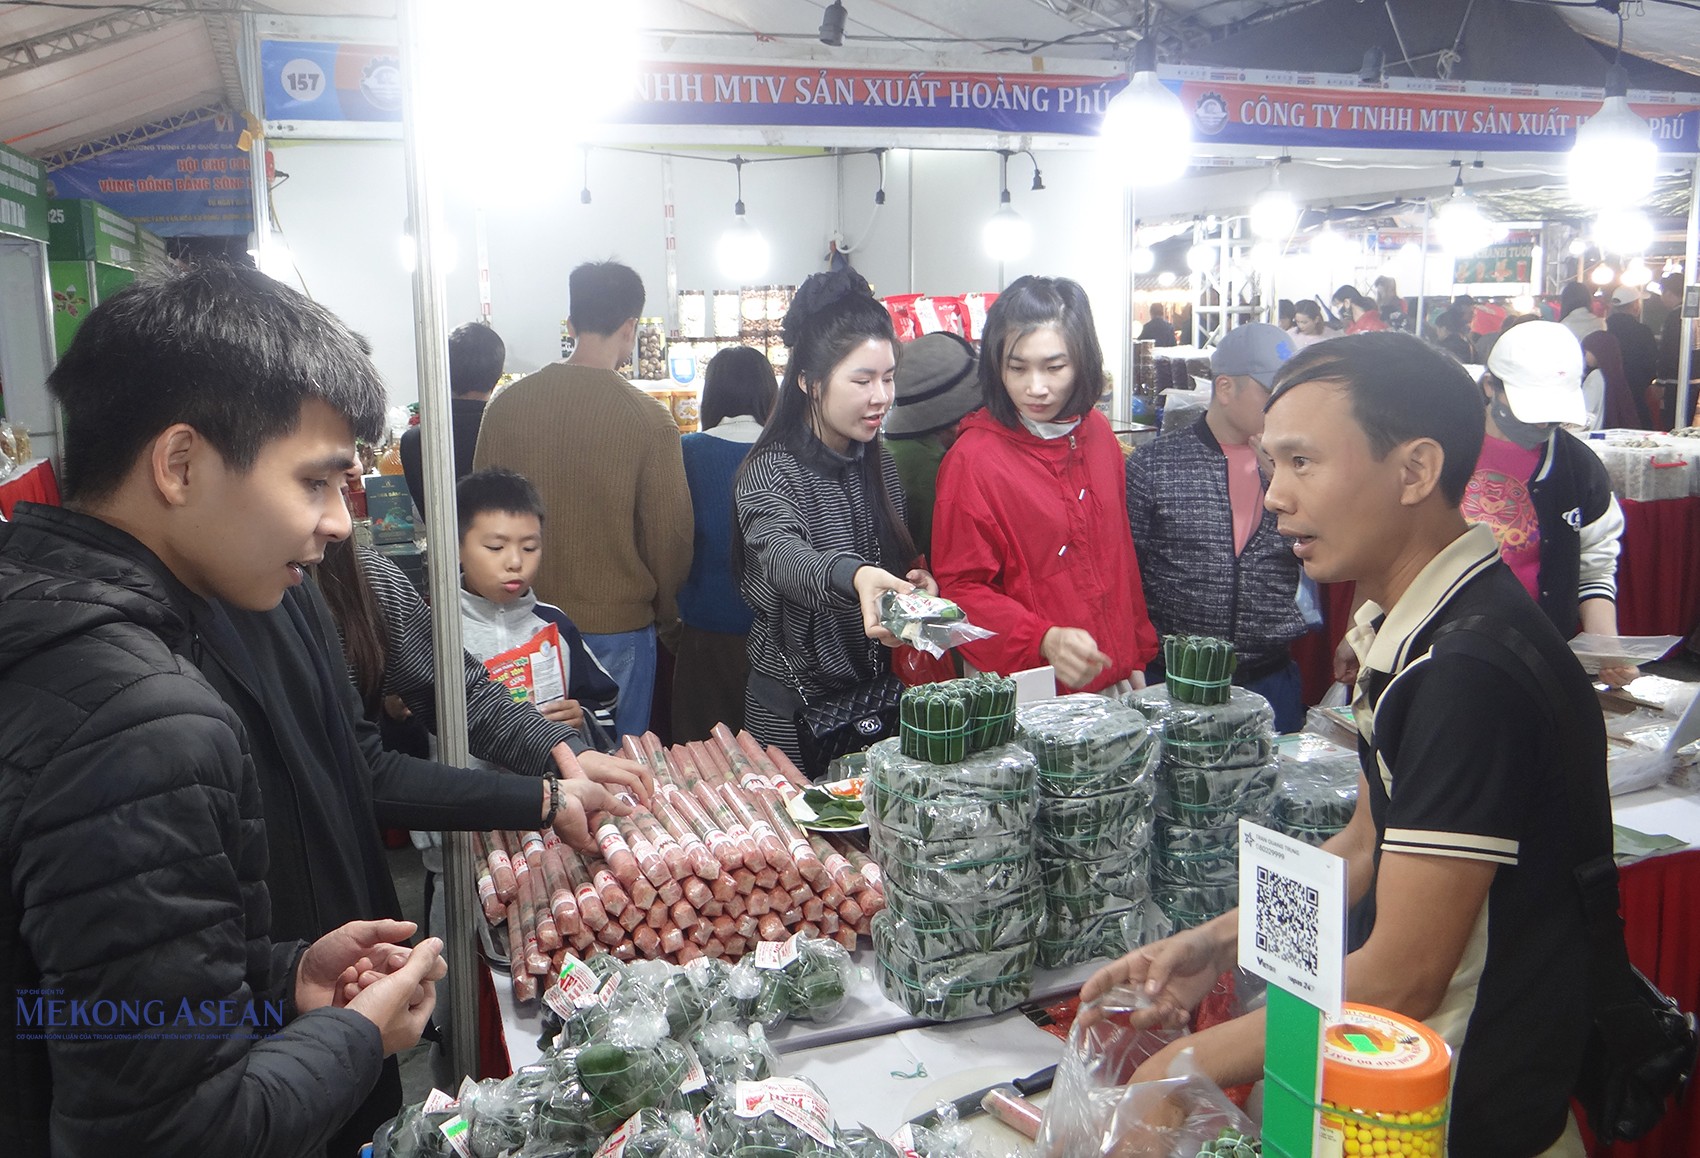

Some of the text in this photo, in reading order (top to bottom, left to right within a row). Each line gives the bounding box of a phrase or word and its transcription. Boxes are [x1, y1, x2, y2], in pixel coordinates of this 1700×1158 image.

[287, 73, 320, 91] 157
[713, 74, 787, 104] MTV
[795, 69, 854, 106] SẢN
[863, 72, 941, 107] XUẤT
[949, 77, 1049, 112] HOÀNG
[1240, 95, 1305, 127] CÔNG
[1311, 104, 1342, 128] TY
[1348, 105, 1413, 131] TNHH
[1419, 109, 1467, 133] MTV
[1472, 104, 1512, 135] SẢN
[1516, 107, 1570, 136] XUẤT
[1649, 113, 1685, 140] PhÚ
[176, 156, 199, 175] HỘI
[201, 157, 227, 173] CHỢ
[98, 176, 135, 193] VÙNG
